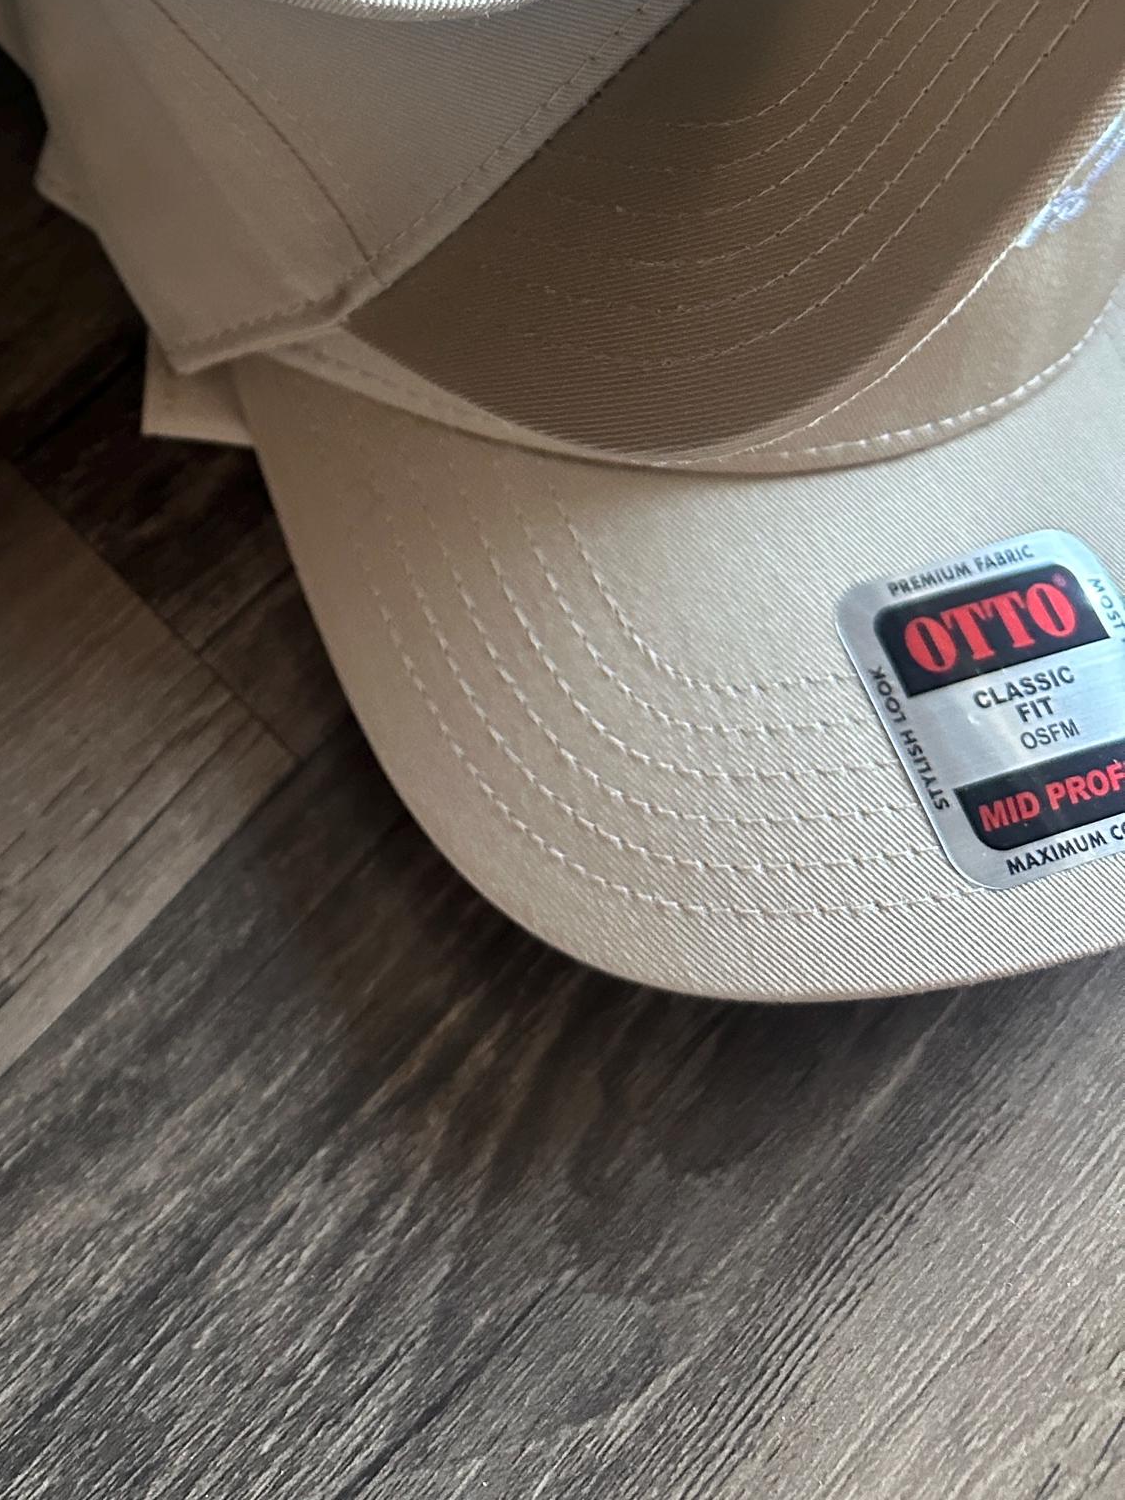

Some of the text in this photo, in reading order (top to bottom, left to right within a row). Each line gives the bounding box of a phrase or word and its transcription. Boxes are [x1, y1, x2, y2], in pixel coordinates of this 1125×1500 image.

[887, 544, 1035, 597] PREMIUM FABRIC
[904, 581, 1077, 674] OTTO
[973, 665, 1076, 709] CLASSIC
[1019, 695, 1054, 725] FIT
[868, 665, 951, 811] STYLISH LOOK
[1020, 719, 1081, 751] OSFM
[978, 762, 1125, 832] MID PROF
[1006, 830, 1108, 876] MAXIMUM
